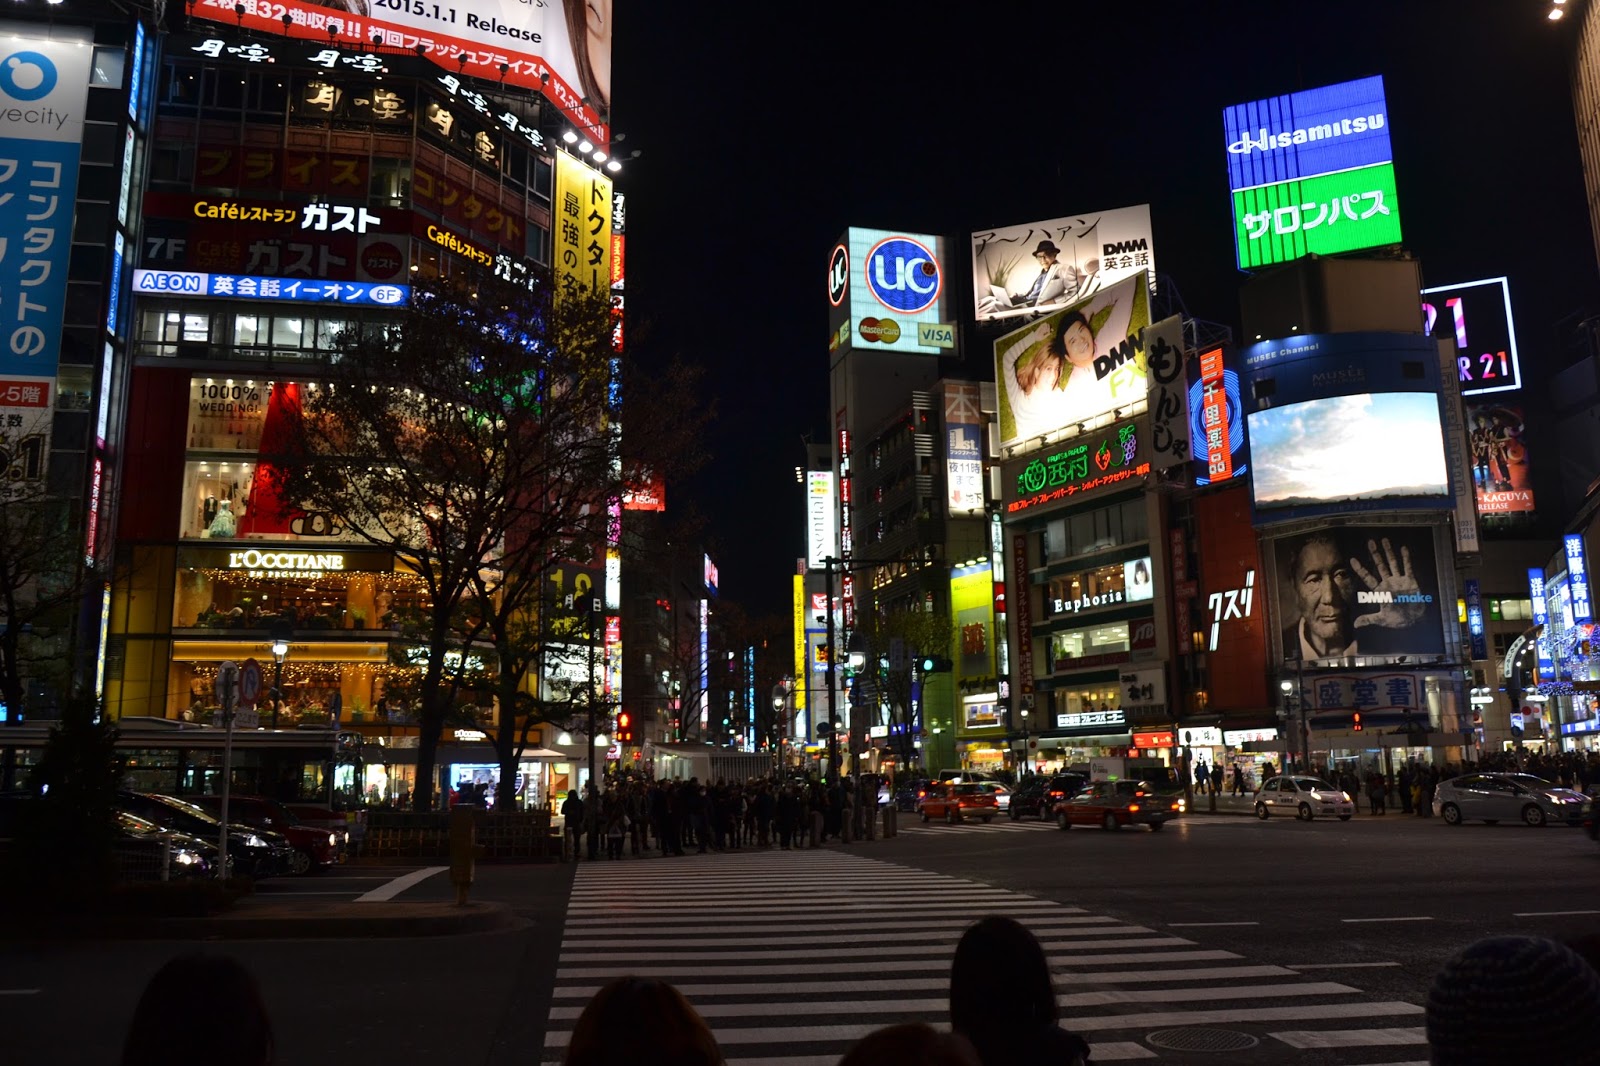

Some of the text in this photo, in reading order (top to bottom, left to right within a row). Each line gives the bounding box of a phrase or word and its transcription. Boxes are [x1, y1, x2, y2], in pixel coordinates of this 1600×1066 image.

[466, 13, 542, 43] Release
[1227, 113, 1385, 154] Hisamitsu
[301, 203, 381, 234] ガスト
[1242, 189, 1390, 240] サロンパス
[9, 160, 62, 356] コンタクトの
[147, 237, 186, 259] 7F
[246, 238, 347, 278] ガスト
[1103, 238, 1148, 256] DMM
[1104, 253, 1149, 271] 英会話
[140, 273, 200, 292] AEON
[213, 276, 395, 301] 英会話イーオン 6F
[860, 325, 900, 336] MasterCard
[922, 329, 952, 342] VISA
[1246, 343, 1319, 364] MUSEE Channel
[1479, 350, 1508, 379] 21
[200, 384, 259, 401] 1000%
[1147, 336, 1188, 460] もんじゃ
[199, 402, 258, 413] WEDDING!
[1202, 355, 1226, 475] 三千里薬品
[949, 461, 980, 474] 夜11時
[1048, 454, 1088, 486] 西村
[1478, 502, 1509, 511] RELEASE
[1483, 492, 1529, 502] KAGUYA
[229, 549, 344, 570] L'OCCITANE
[1054, 589, 1123, 613] Euphoria
[1357, 591, 1433, 604] DMM.make
[1132, 622, 1154, 644] JTB
